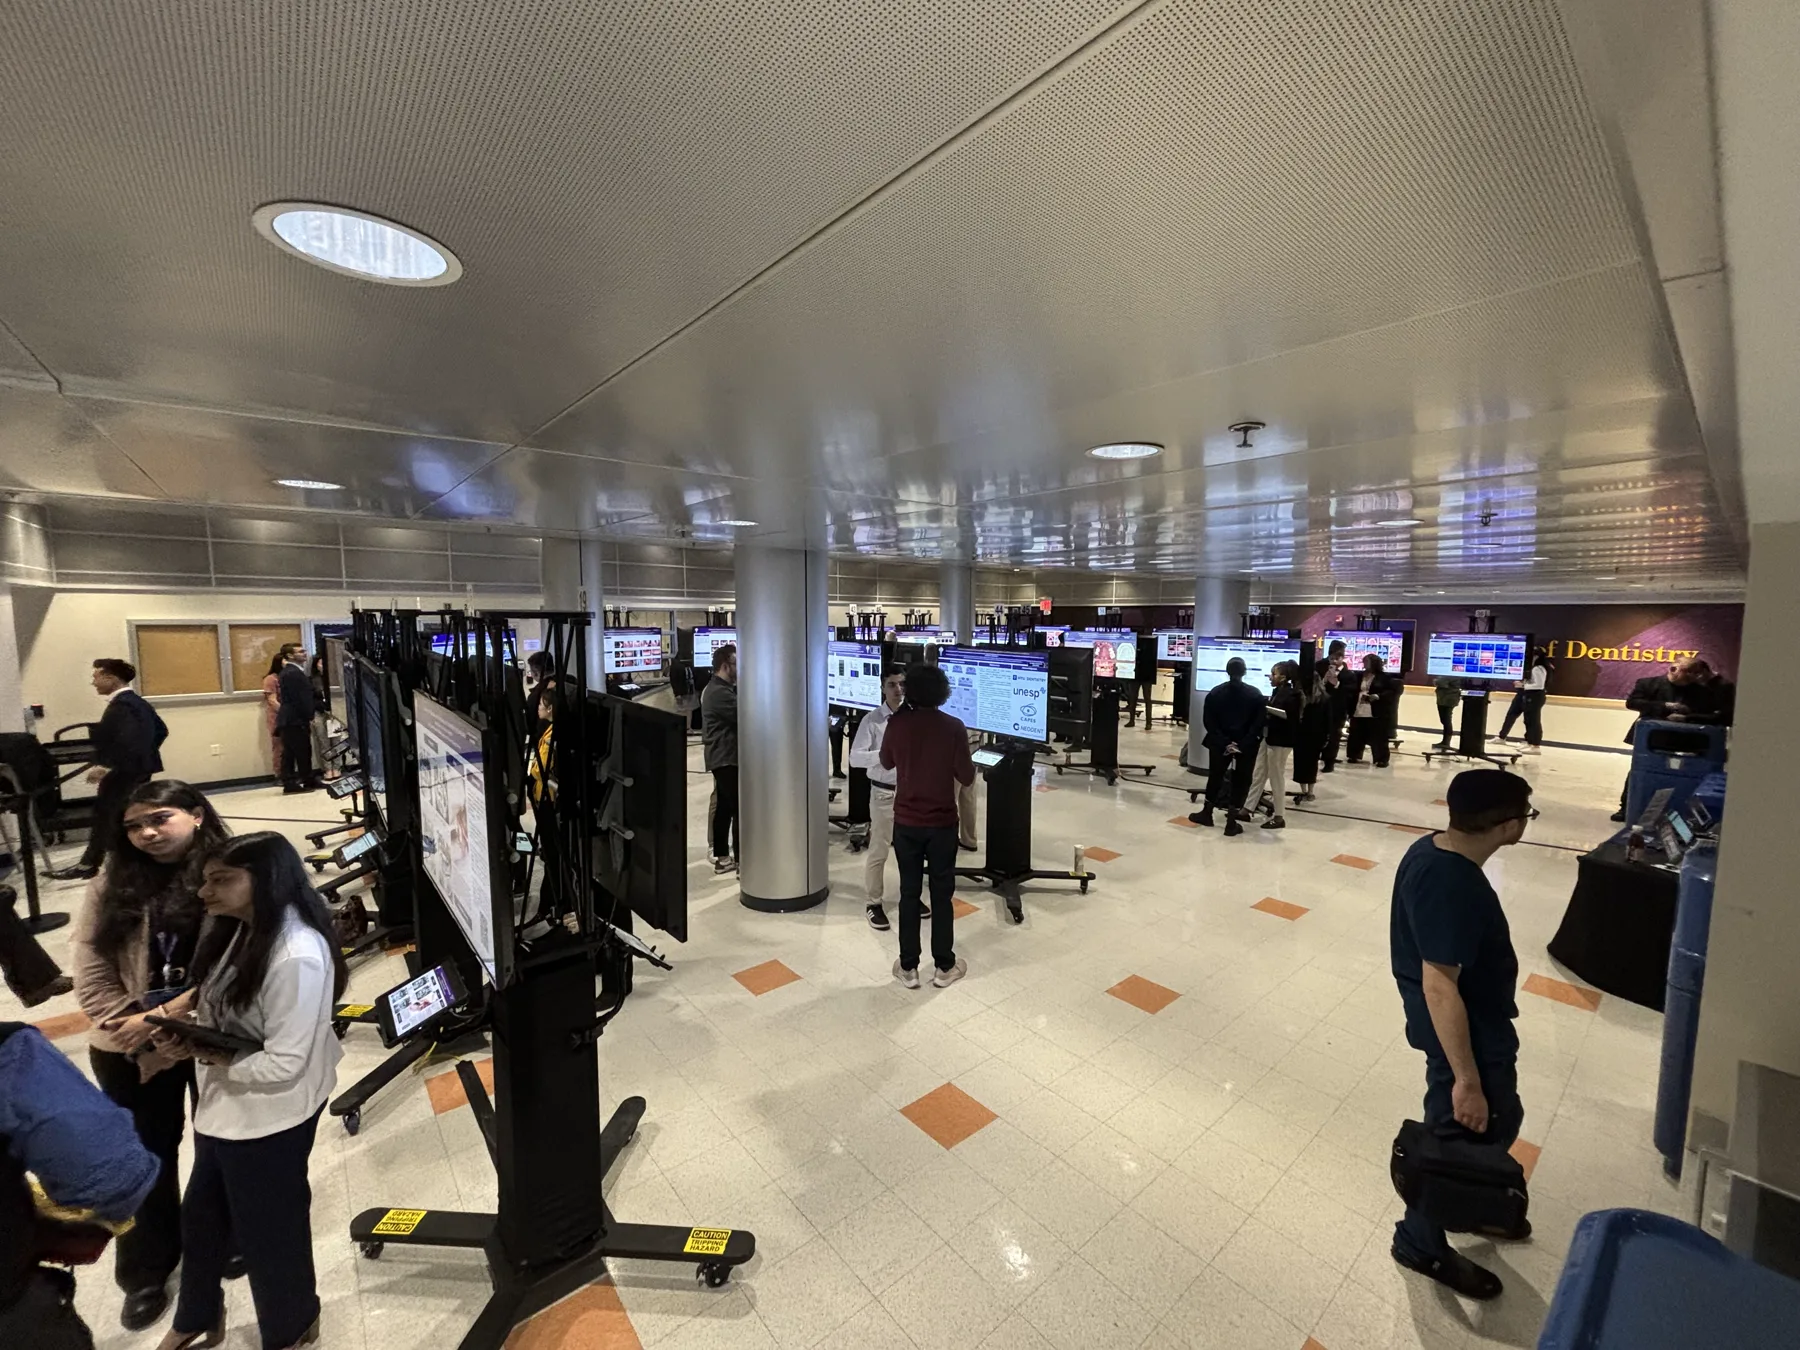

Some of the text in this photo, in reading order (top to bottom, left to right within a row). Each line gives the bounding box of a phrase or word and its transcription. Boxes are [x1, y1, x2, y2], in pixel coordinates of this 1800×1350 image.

[1540, 640, 1699, 662] f Dentistry
[1014, 688, 1039, 700] unesp
[694, 1231, 727, 1239] CAUTION
